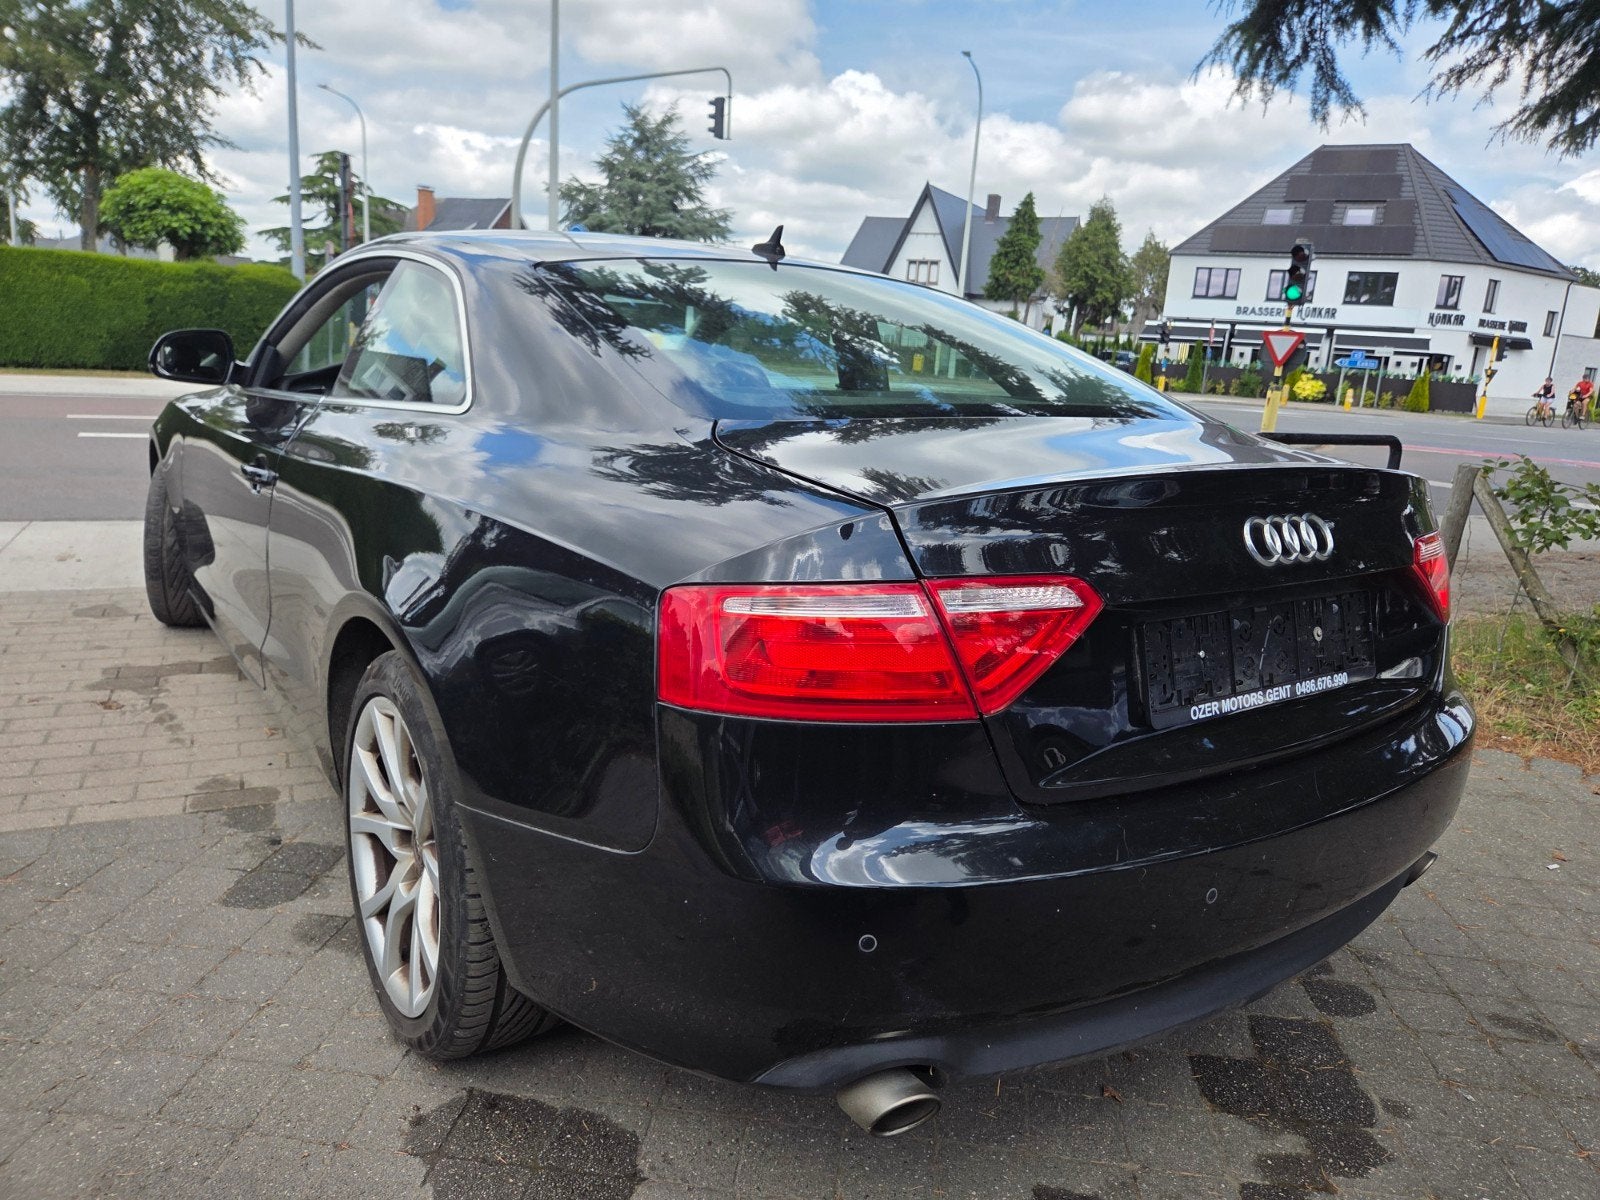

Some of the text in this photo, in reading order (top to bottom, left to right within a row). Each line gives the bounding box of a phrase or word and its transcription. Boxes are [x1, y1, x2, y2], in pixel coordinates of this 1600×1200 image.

[1235, 306, 1286, 317] BRASSERI
[1190, 671, 1348, 720] OZER MOTORS GENT 0486.676.990
